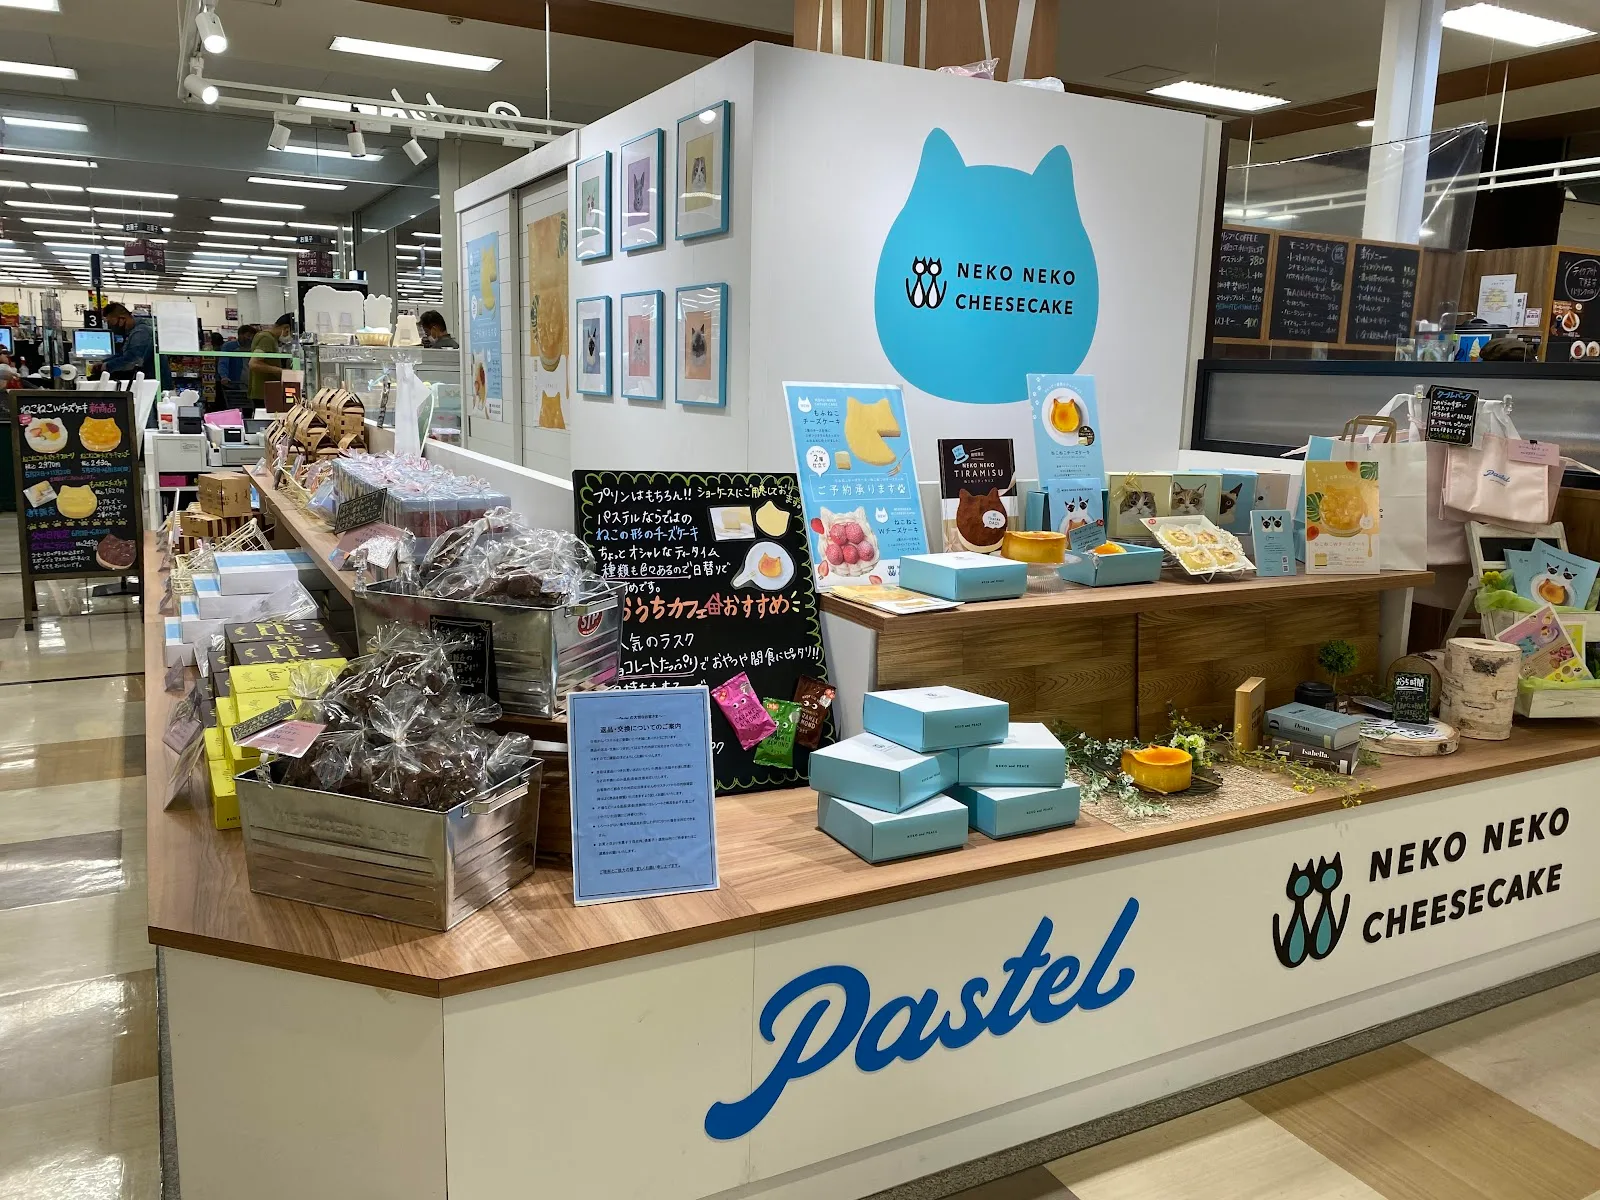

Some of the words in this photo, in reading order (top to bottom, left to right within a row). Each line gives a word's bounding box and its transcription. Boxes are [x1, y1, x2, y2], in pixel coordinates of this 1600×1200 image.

[1289, 241, 1331, 253] モーニングセット
[1360, 246, 1389, 261] 新メニュー
[1250, 255, 1265, 266] 380
[957, 262, 1013, 281] NEKO
[1023, 267, 1075, 285] NEKO
[955, 293, 1074, 315] CHEESECAKE
[89, 315, 97, 327] 3
[1243, 317, 1259, 328] 400
[89, 402, 116, 414] 新商品
[814, 409, 840, 417] もふねこ
[954, 469, 1004, 478] TIRAMISU
[1483, 469, 1511, 483] Pastel
[593, 487, 692, 504] プリンはもちろん!!
[818, 483, 895, 496] ご予約承ります
[598, 509, 692, 525] パステルならではの
[31, 529, 71, 539] 父の日限定
[596, 525, 698, 541] ねこの形のチーズケーキ
[601, 561, 731, 578] 種類も色々あるので日替りで
[723, 594, 790, 618] おすすめ
[600, 722, 682, 734] 返品・交換についてのご案内
[1301, 748, 1330, 759] Isabella.
[1368, 829, 1466, 882] NEKO
[1483, 806, 1571, 856] NEKO
[1362, 863, 1564, 944] CHEESECAKE
[705, 896, 1139, 1141] Pastel
